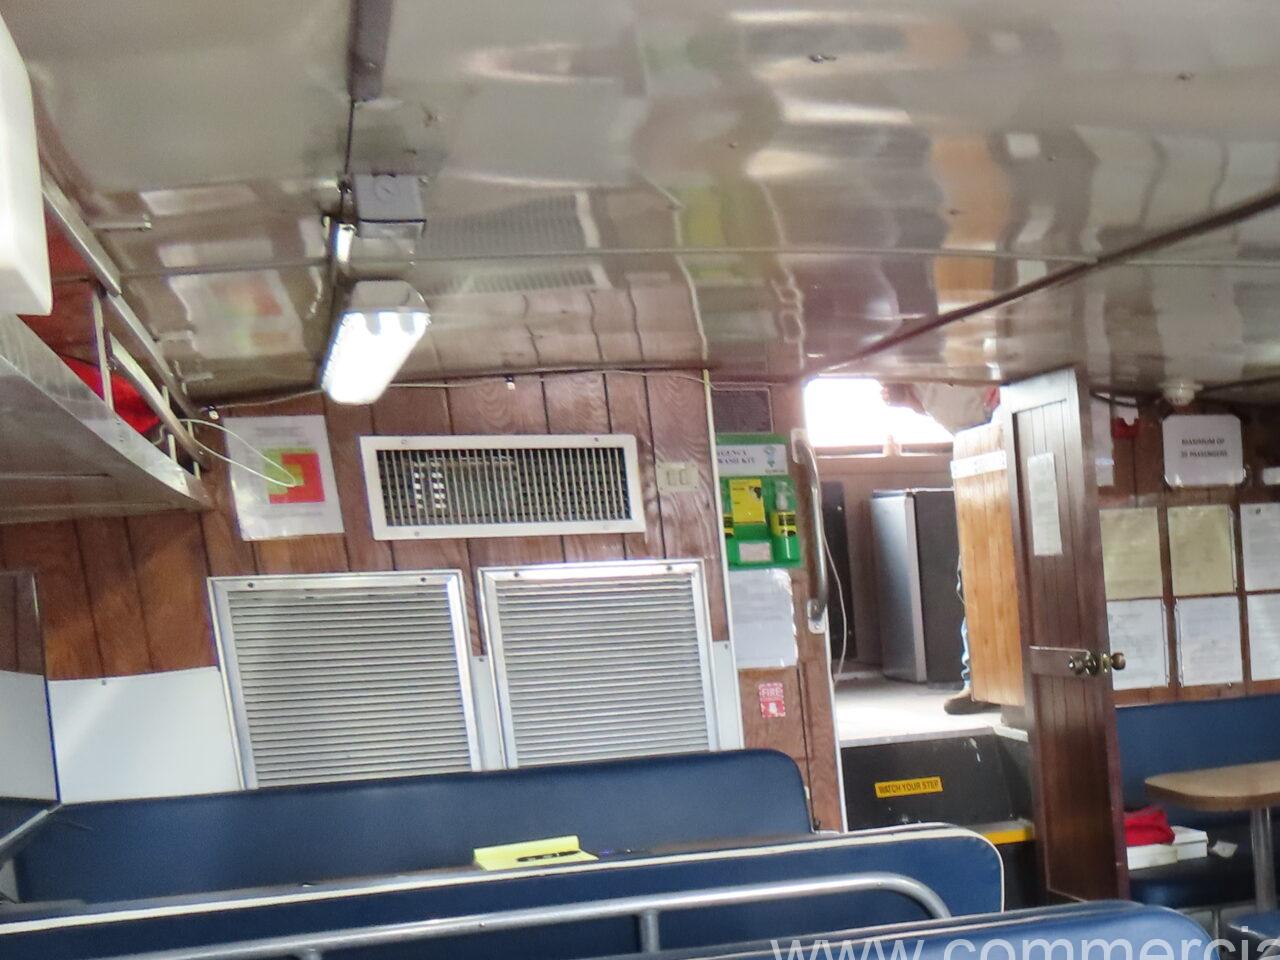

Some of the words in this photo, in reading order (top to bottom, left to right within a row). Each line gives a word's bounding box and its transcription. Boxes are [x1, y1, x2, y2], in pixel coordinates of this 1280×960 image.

[878, 784, 901, 794] WATCH
[902, 782, 921, 791] YOUR
[922, 780, 939, 790] STEP
